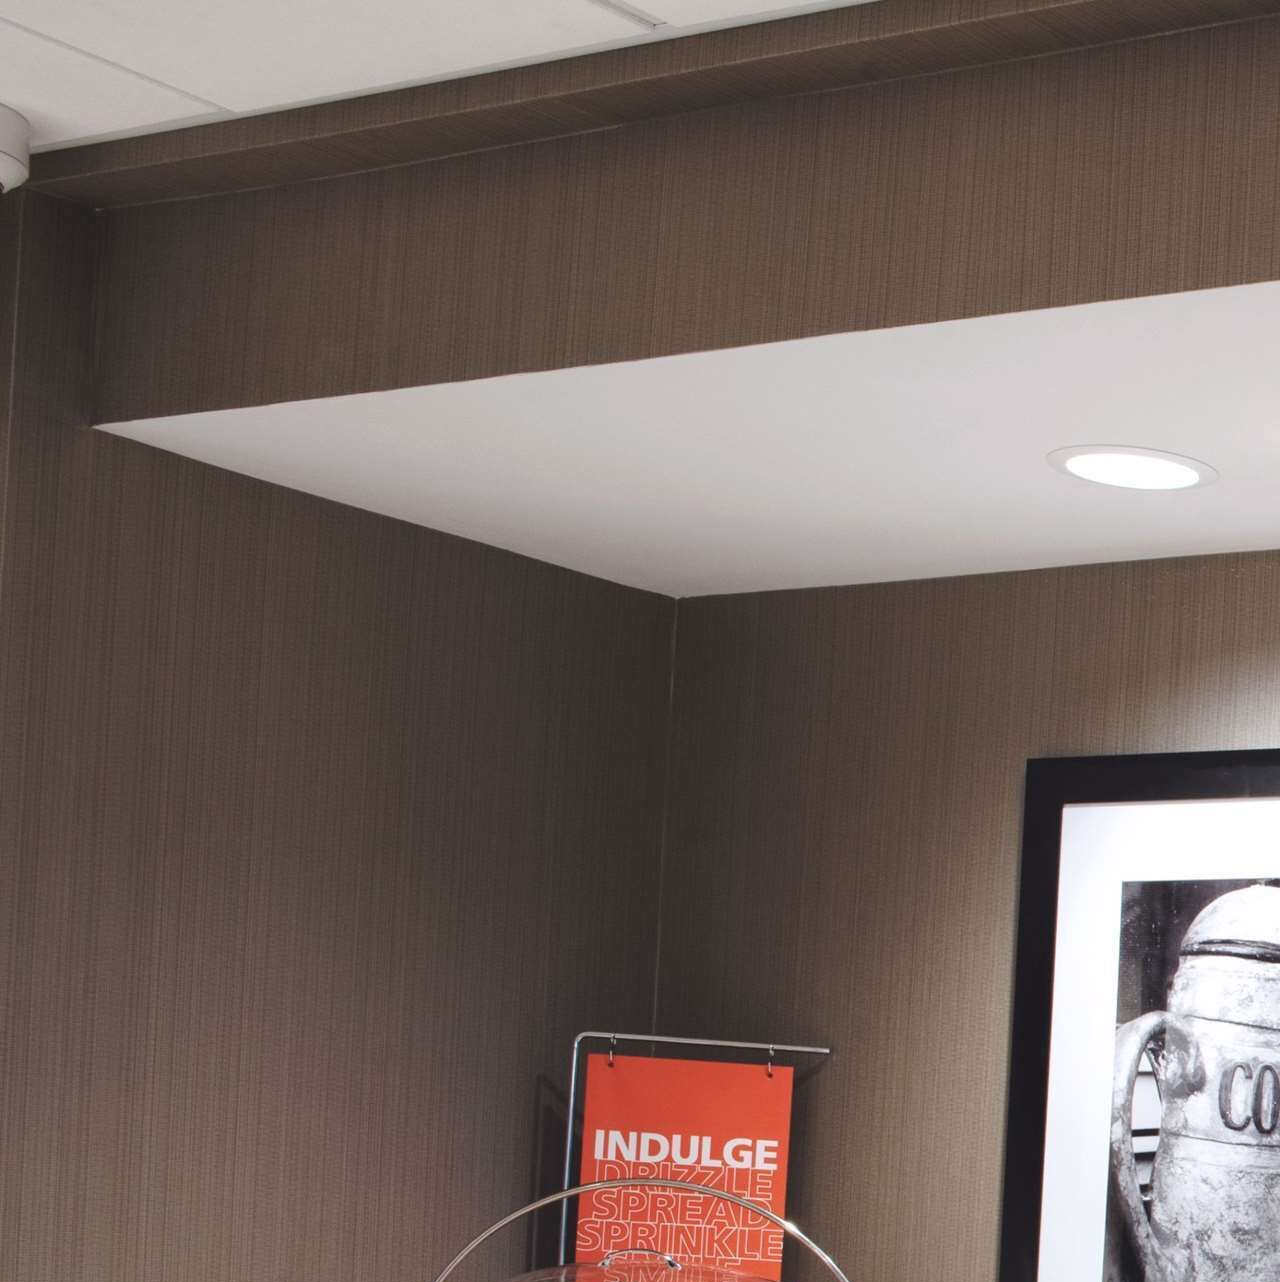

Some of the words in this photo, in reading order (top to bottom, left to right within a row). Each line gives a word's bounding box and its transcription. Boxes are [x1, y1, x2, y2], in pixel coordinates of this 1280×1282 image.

[594, 1129, 779, 1171] INDULGE
[595, 1158, 775, 1200] DRIZZLE
[591, 1189, 774, 1230] SPREAD
[575, 1218, 784, 1262] SPRINKLE
